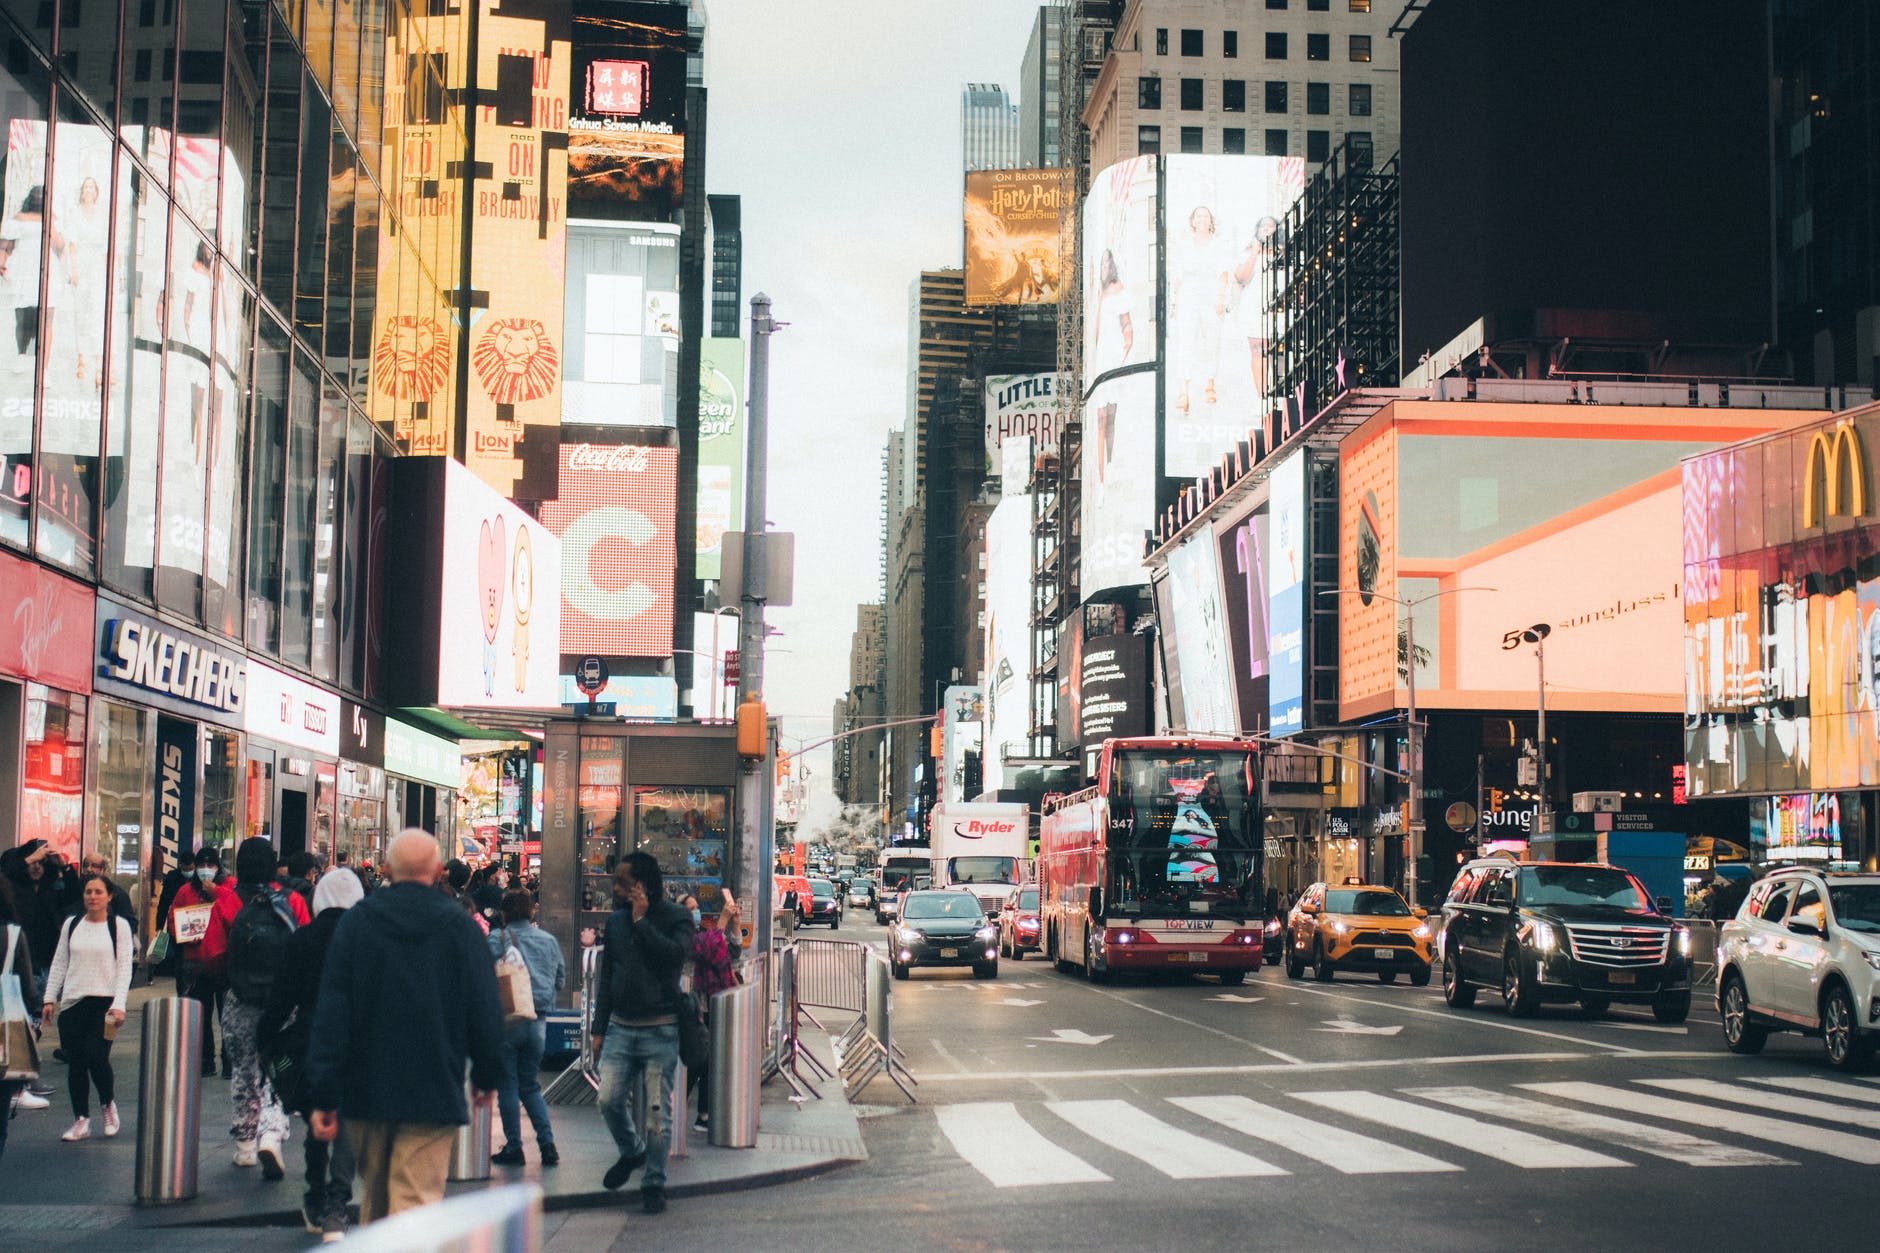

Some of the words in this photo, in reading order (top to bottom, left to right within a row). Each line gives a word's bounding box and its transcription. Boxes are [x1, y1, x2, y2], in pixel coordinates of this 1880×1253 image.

[603, 118, 639, 132] Screen
[640, 121, 674, 135] Media
[508, 142, 534, 177] ON
[995, 173, 1012, 182] ON
[989, 188, 1031, 216] Harry
[629, 235, 676, 248] SAMSUNG
[998, 377, 1052, 411] LITTLE
[475, 430, 509, 453] LION
[1195, 379, 1307, 513] BROADWAY
[1558, 592, 1667, 628] sunglass
[111, 618, 247, 714] SKECHERS
[304, 702, 327, 735] TISSOT
[596, 703, 608, 713] M7
[843, 721, 852, 777] WELINGTON
[554, 749, 569, 829] Newsstand
[968, 820, 1016, 836] Ryder
[1111, 818, 1134, 829] 347
